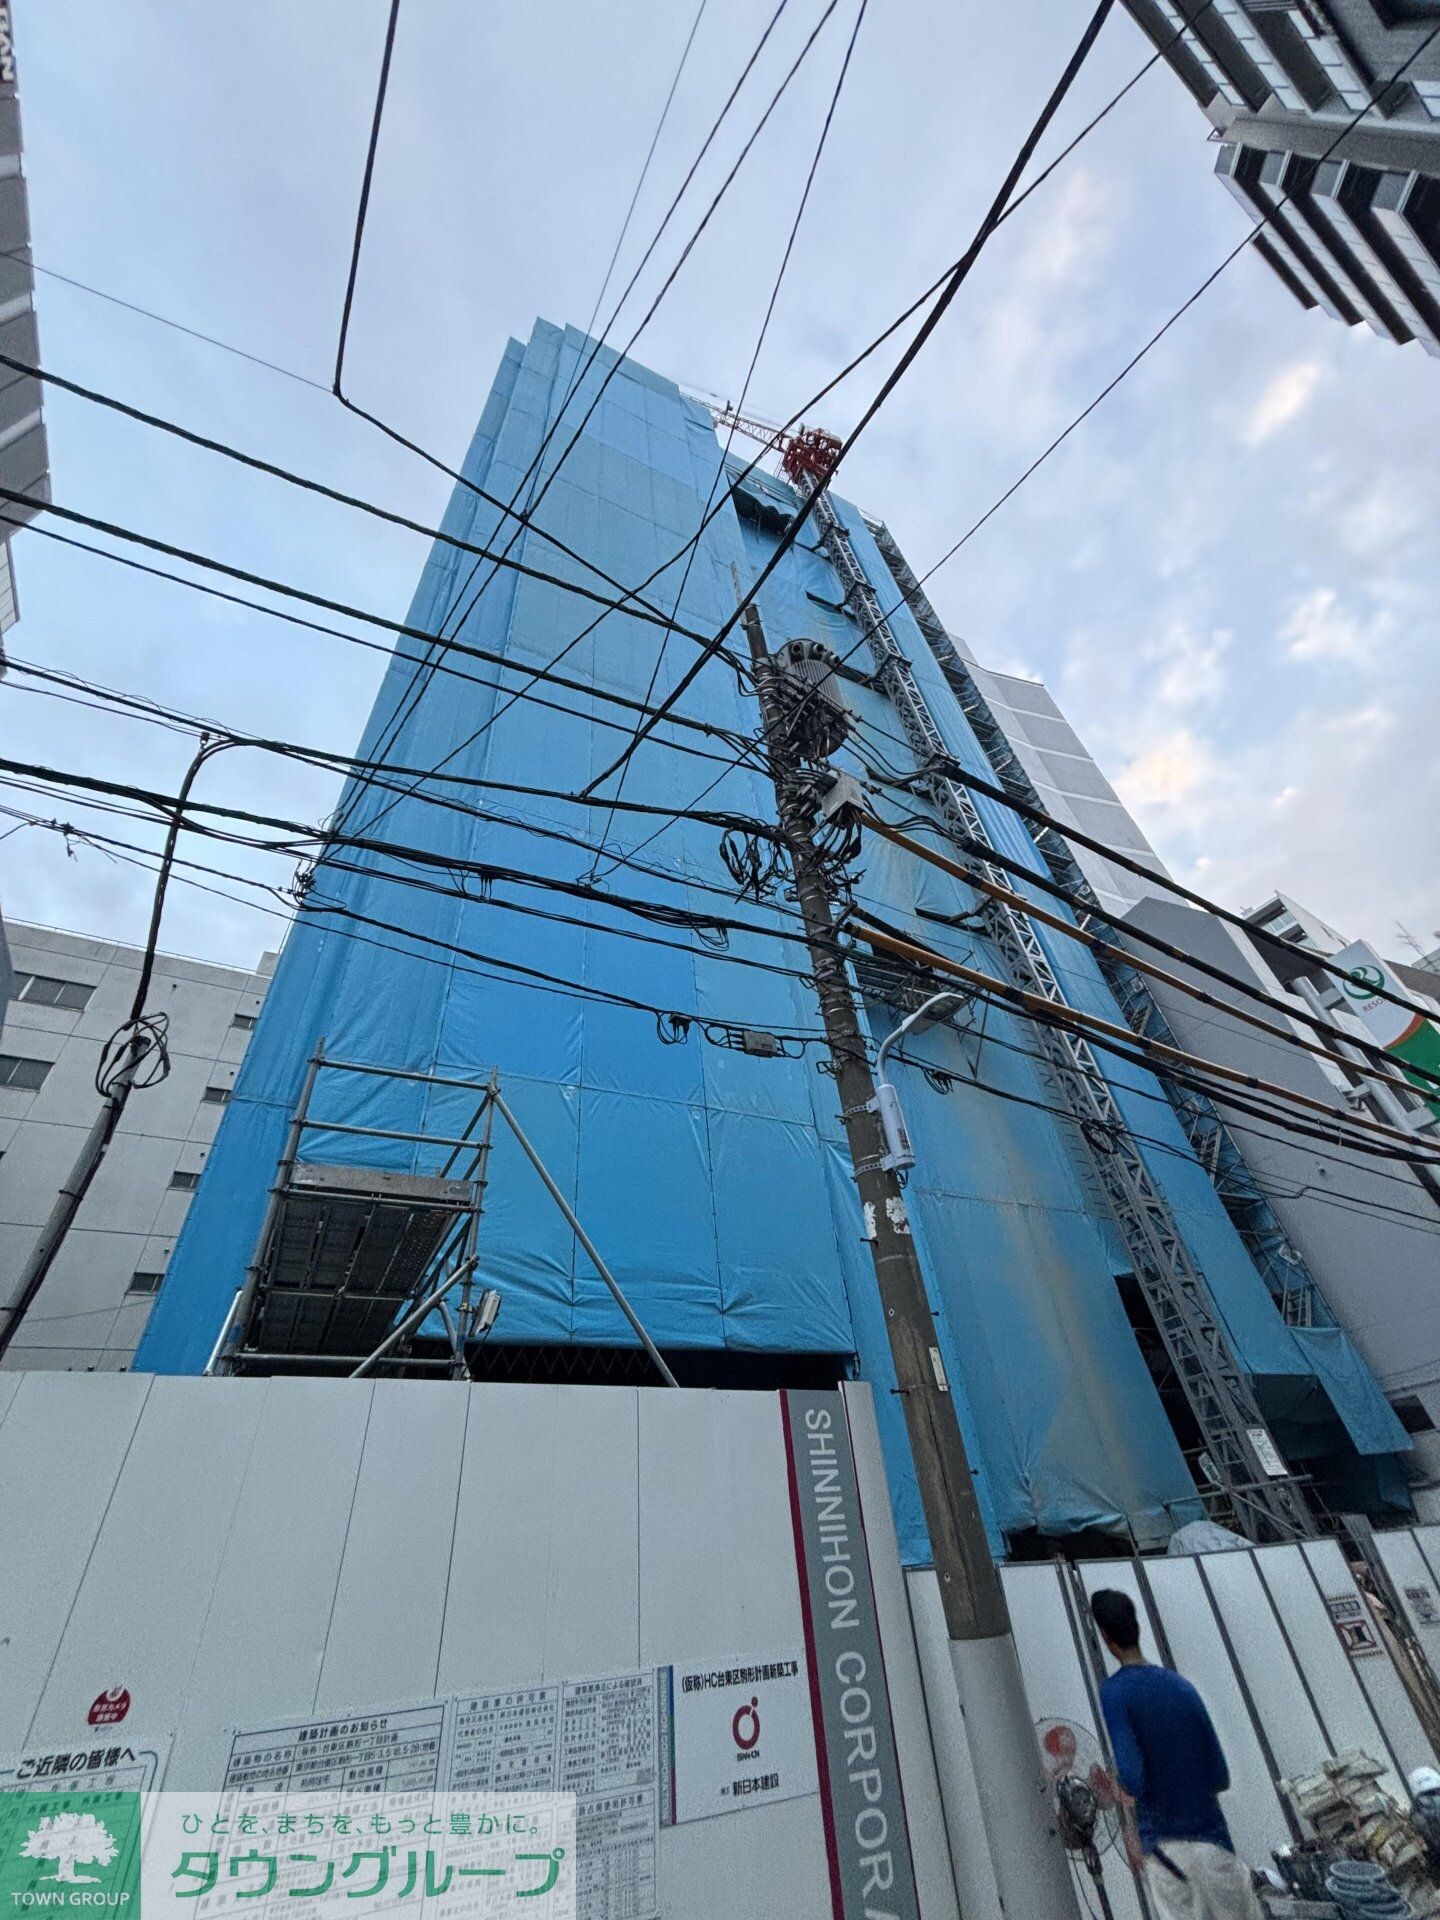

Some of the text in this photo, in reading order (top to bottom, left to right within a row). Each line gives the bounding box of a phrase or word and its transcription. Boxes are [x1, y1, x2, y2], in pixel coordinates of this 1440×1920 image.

[805, 1408, 860, 1629] SHINNIHON
[299, 1719, 387, 1741] 建築計画のお知らせ
[17, 1747, 135, 1779] ご近隣の皆様へ
[733, 1773, 779, 1797] 新日本建設
